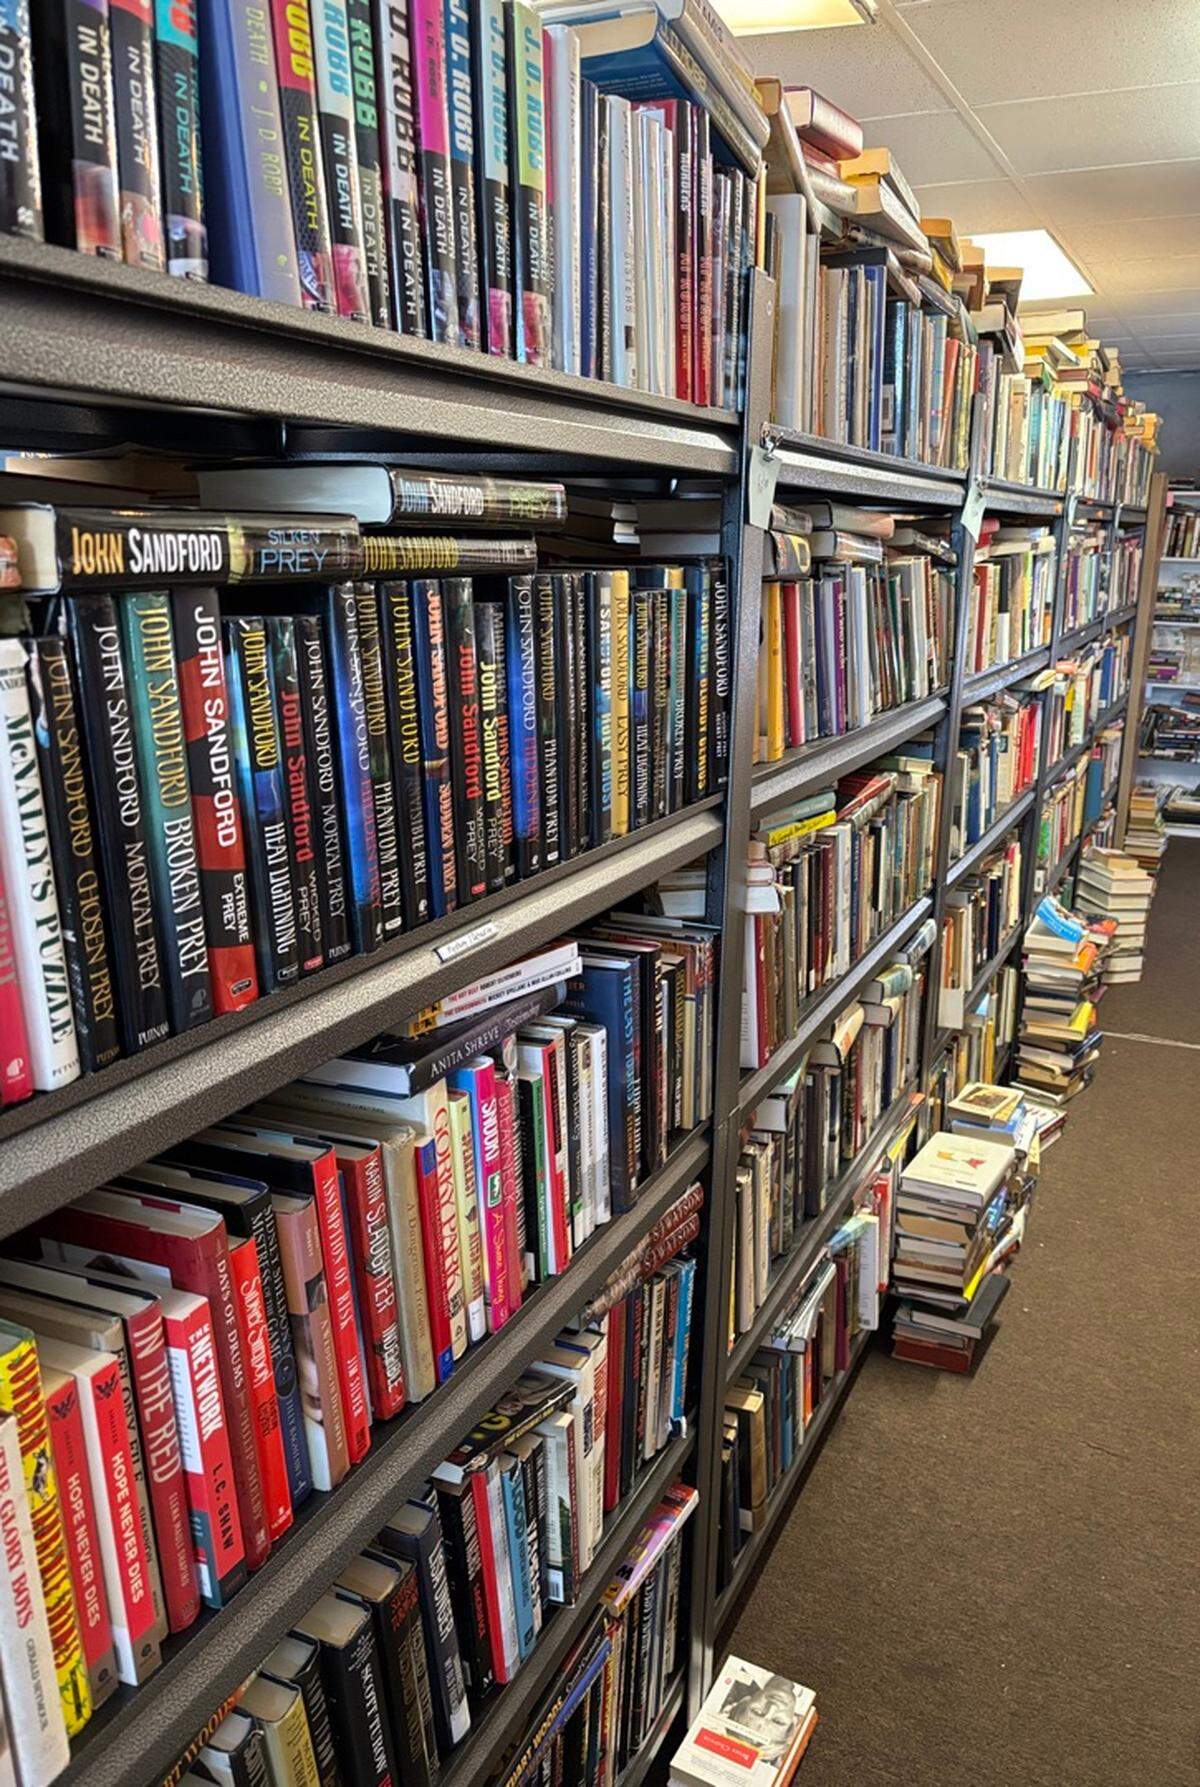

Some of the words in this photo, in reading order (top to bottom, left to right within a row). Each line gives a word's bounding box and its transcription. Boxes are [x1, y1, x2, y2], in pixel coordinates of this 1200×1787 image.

[77, 26, 97, 59] IN
[126, 46, 141, 72] IN
[246, 8, 269, 66] DEATH
[523, 27, 541, 54] J.
[174, 73, 188, 98] IN
[350, 17, 378, 129] ROBB
[525, 59, 542, 88] D.
[0, 48, 20, 163] DEATH
[79, 62, 104, 145] DEATH
[129, 77, 145, 165] DEATH
[297, 115, 310, 144] IN
[391, 54, 416, 174] ROBB
[452, 67, 473, 157] ROBB
[492, 86, 508, 165] ROBB
[526, 94, 543, 171] ROBB
[176, 110, 193, 194] DEATH
[332, 133, 346, 157] IN
[301, 148, 318, 231] DEATH
[335, 162, 354, 230] DEATH
[361, 177, 372, 198] IN
[433, 168, 444, 192] IN
[458, 186, 468, 205] IN
[495, 196, 505, 218] IN
[362, 202, 379, 277] DEATH
[400, 207, 412, 227] IN
[433, 196, 449, 256] DEATH
[528, 202, 539, 220] IN
[459, 211, 472, 277] DEATH
[494, 223, 506, 279] DEATH
[528, 226, 541, 282] DEATH
[402, 234, 418, 316] DEATH
[430, 480, 485, 516] SANDFORD
[71, 528, 125, 576] JOHN
[128, 527, 223, 574] SANDFORD
[260, 546, 330, 575] PREY
[267, 529, 321, 546] SILKEN
[362, 535, 398, 572] JOHN
[343, 592, 360, 652] JOHN
[357, 593, 379, 639] JOHN
[389, 594, 413, 654] JOHN
[425, 589, 443, 644] JOHN
[514, 583, 532, 634] JOHN
[537, 584, 553, 622] JOHN
[614, 595, 628, 628] JOHN
[714, 580, 728, 620] JOHN
[94, 623, 125, 691] JOHN
[138, 606, 176, 676] JOHN
[190, 605, 224, 689] JOHN
[242, 628, 268, 676] JOHN
[303, 637, 324, 690] JOHN
[457, 644, 476, 695] John
[539, 627, 554, 701] SANDFORD
[616, 633, 628, 701] SANDFORD
[714, 622, 728, 696] SANDFORD
[46, 653, 75, 720] JOHN
[361, 646, 386, 736] SANDFORD
[393, 657, 422, 764] SANDFORD
[429, 649, 449, 748] SANDFORD
[478, 660, 498, 710] John
[518, 637, 536, 730] SANDFORD
[148, 679, 194, 808] SANDFORD
[248, 678, 277, 767] SANDFORD
[280, 689, 304, 748] John
[309, 695, 335, 792] SANDFORD
[104, 699, 142, 827] SANDFORD
[200, 697, 242, 848] SANDFORD
[459, 703, 484, 799] Sandford
[479, 718, 504, 801] Sandford
[543, 738, 557, 806] PHANTOM
[616, 758, 629, 798] PREY
[56, 727, 92, 858] SANDFORD
[286, 755, 315, 862] Sandford
[372, 781, 397, 863] PHANTOM
[263, 823, 288, 865] HEAT
[320, 804, 342, 874] MORTAL
[464, 820, 477, 863] PREY
[473, 806, 486, 871] WICKED
[486, 818, 499, 855] PREY
[544, 810, 558, 843] PREY
[3, 714, 56, 902] McNALLY'S
[33, 916, 76, 1043] PUZZLE
[123, 842, 152, 933] MORTAL
[166, 816, 205, 912] BROKEN
[380, 868, 401, 909] PREY
[410, 852, 427, 885] PREY
[74, 870, 106, 963] CHOSEN
[219, 892, 237, 932] PREY
[229, 872, 252, 941] EXTREME
[296, 886, 312, 933] PREY
[306, 870, 322, 942] WICKED
[326, 877, 346, 918] PREY
[134, 939, 159, 990] PREY
[180, 919, 209, 974] PREY
[87, 971, 113, 1022] PREY
[430, 1044, 463, 1078] ANITA
[464, 1027, 499, 1059] SHREVE
[431, 1103, 457, 1214] GORKY
[497, 1092, 515, 1208] BREAKNECK
[361, 1157, 384, 1205] KARIN
[320, 1176, 345, 1264] ASSUMPTION
[332, 1267, 348, 1288] OF
[364, 1202, 398, 1313] SLAUGHTER
[439, 1210, 463, 1291] PARK
[249, 1212, 273, 1286] MISTRESS
[264, 1317, 283, 1359] GAME
[335, 1294, 354, 1330] RISK
[130, 1319, 164, 1358] IN
[188, 1322, 210, 1343] THE
[215, 1259, 232, 1300] DAYS
[225, 1331, 245, 1388] DRUMS
[137, 1363, 174, 1423] THE
[185, 1338, 225, 1442] NETWORK
[345, 1355, 359, 1377] JIM
[347, 1377, 365, 1418] SILVER
[109, 1451, 129, 1502] HOPE
[146, 1425, 182, 1484] RED
[209, 1464, 227, 1500] L.C.
[65, 1472, 85, 1522] HOPE
[215, 1503, 236, 1550] SHAW
[0, 1495, 23, 1576] GLORY
[72, 1525, 94, 1587] NEVER
[117, 1503, 138, 1563] NEVER
[126, 1564, 144, 1605] DIES
[425, 1539, 447, 1588] LISA
[9, 1571, 33, 1633] BOYS
[82, 1588, 101, 1629] DIES
[431, 1578, 456, 1644] UNGER
[358, 1661, 379, 1721] SCOTT
[366, 1712, 388, 1779] TUROW
